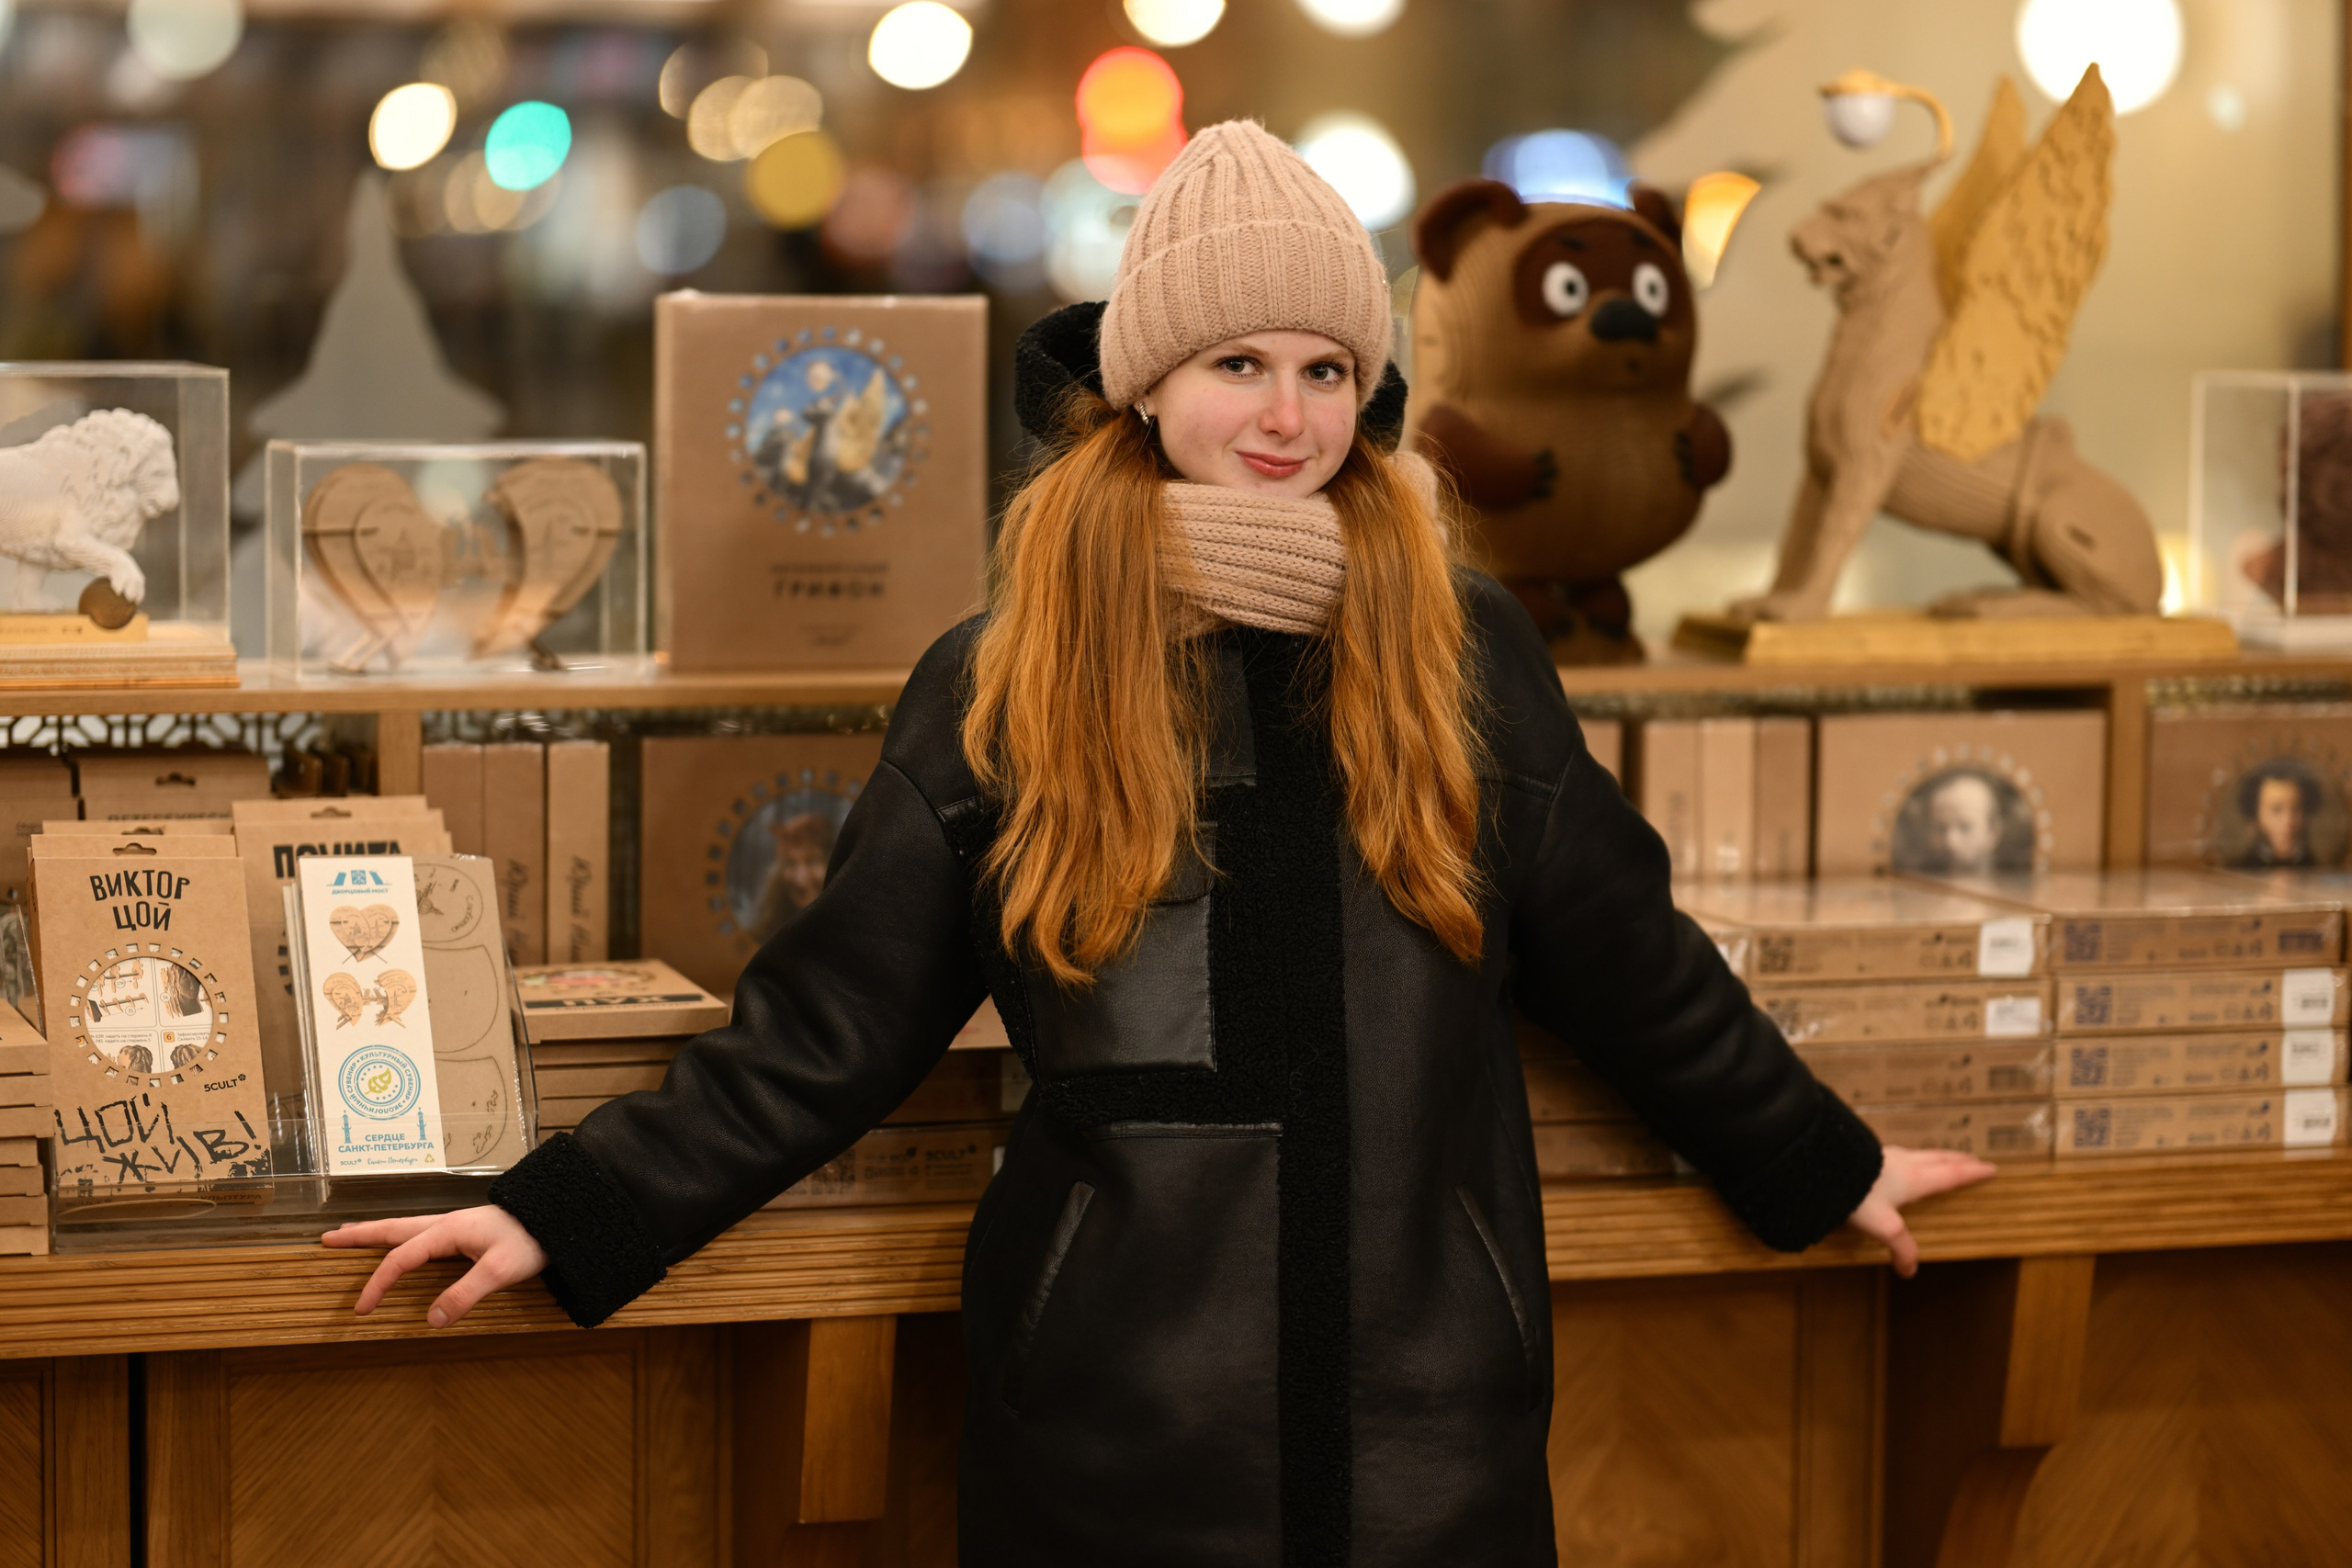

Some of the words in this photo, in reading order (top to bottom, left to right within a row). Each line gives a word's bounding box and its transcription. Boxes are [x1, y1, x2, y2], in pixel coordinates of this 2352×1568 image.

[90, 870, 190, 901] ВИКТОР
[332, 887, 371, 896] ДВОРЦОВЫЙ
[113, 901, 172, 931] ЦОЙ
[360, 1052, 407, 1069] КУЛЬТУРНЫЙ
[204, 1079, 237, 1092] 5CULT
[345, 1062, 356, 1094] СУВЕНИР
[403, 1068, 413, 1100] СУВЕНИР
[349, 1094, 403, 1114] ЭКОЛОГИЧНЫЙ
[54, 1093, 175, 1154] ЦОЙ
[102, 1110, 263, 1185] ЖИВ!
[338, 1142, 434, 1153] САНКТ-ПЕТЕРБУРГА
[365, 1134, 405, 1143] СЕРДЦЕ
